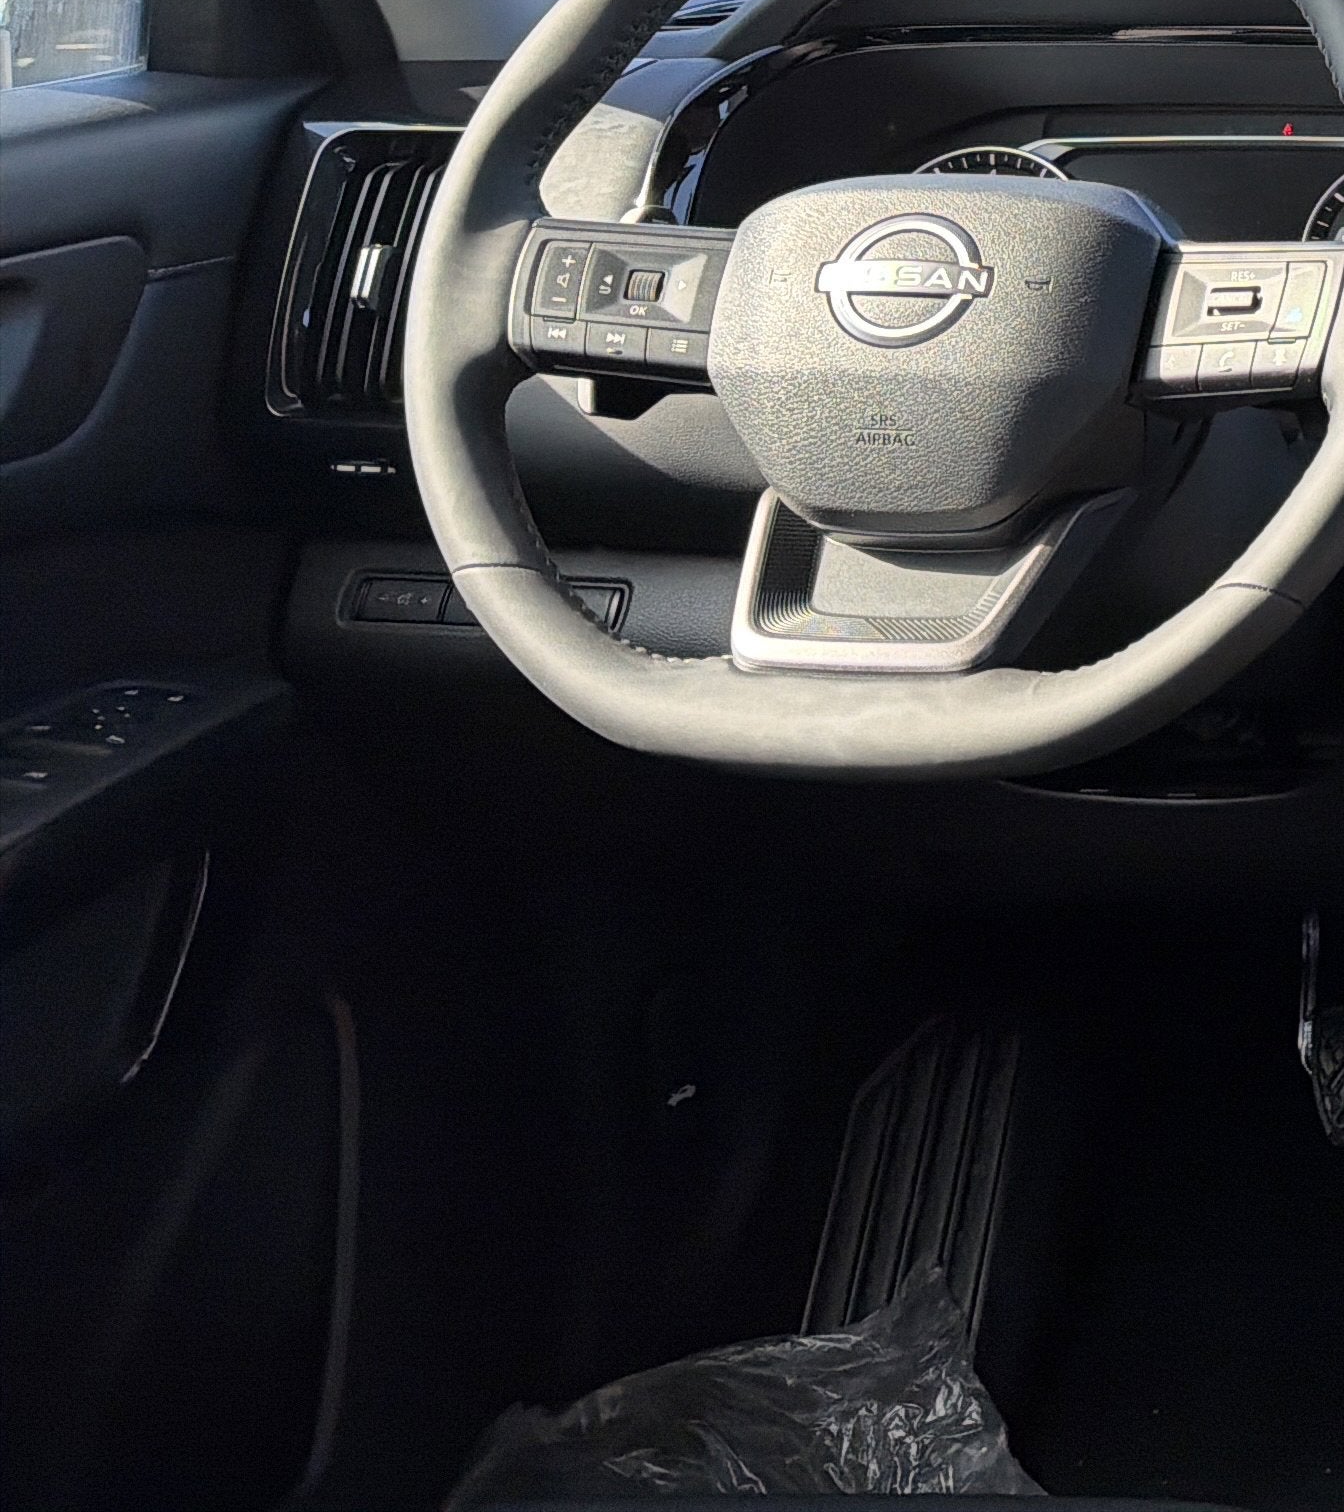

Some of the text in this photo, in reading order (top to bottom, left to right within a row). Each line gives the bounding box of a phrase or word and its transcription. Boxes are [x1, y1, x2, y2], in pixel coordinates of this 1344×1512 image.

[630, 305, 647, 316] OK
[871, 414, 897, 427] SRS
[856, 432, 916, 446] AIRBAG
